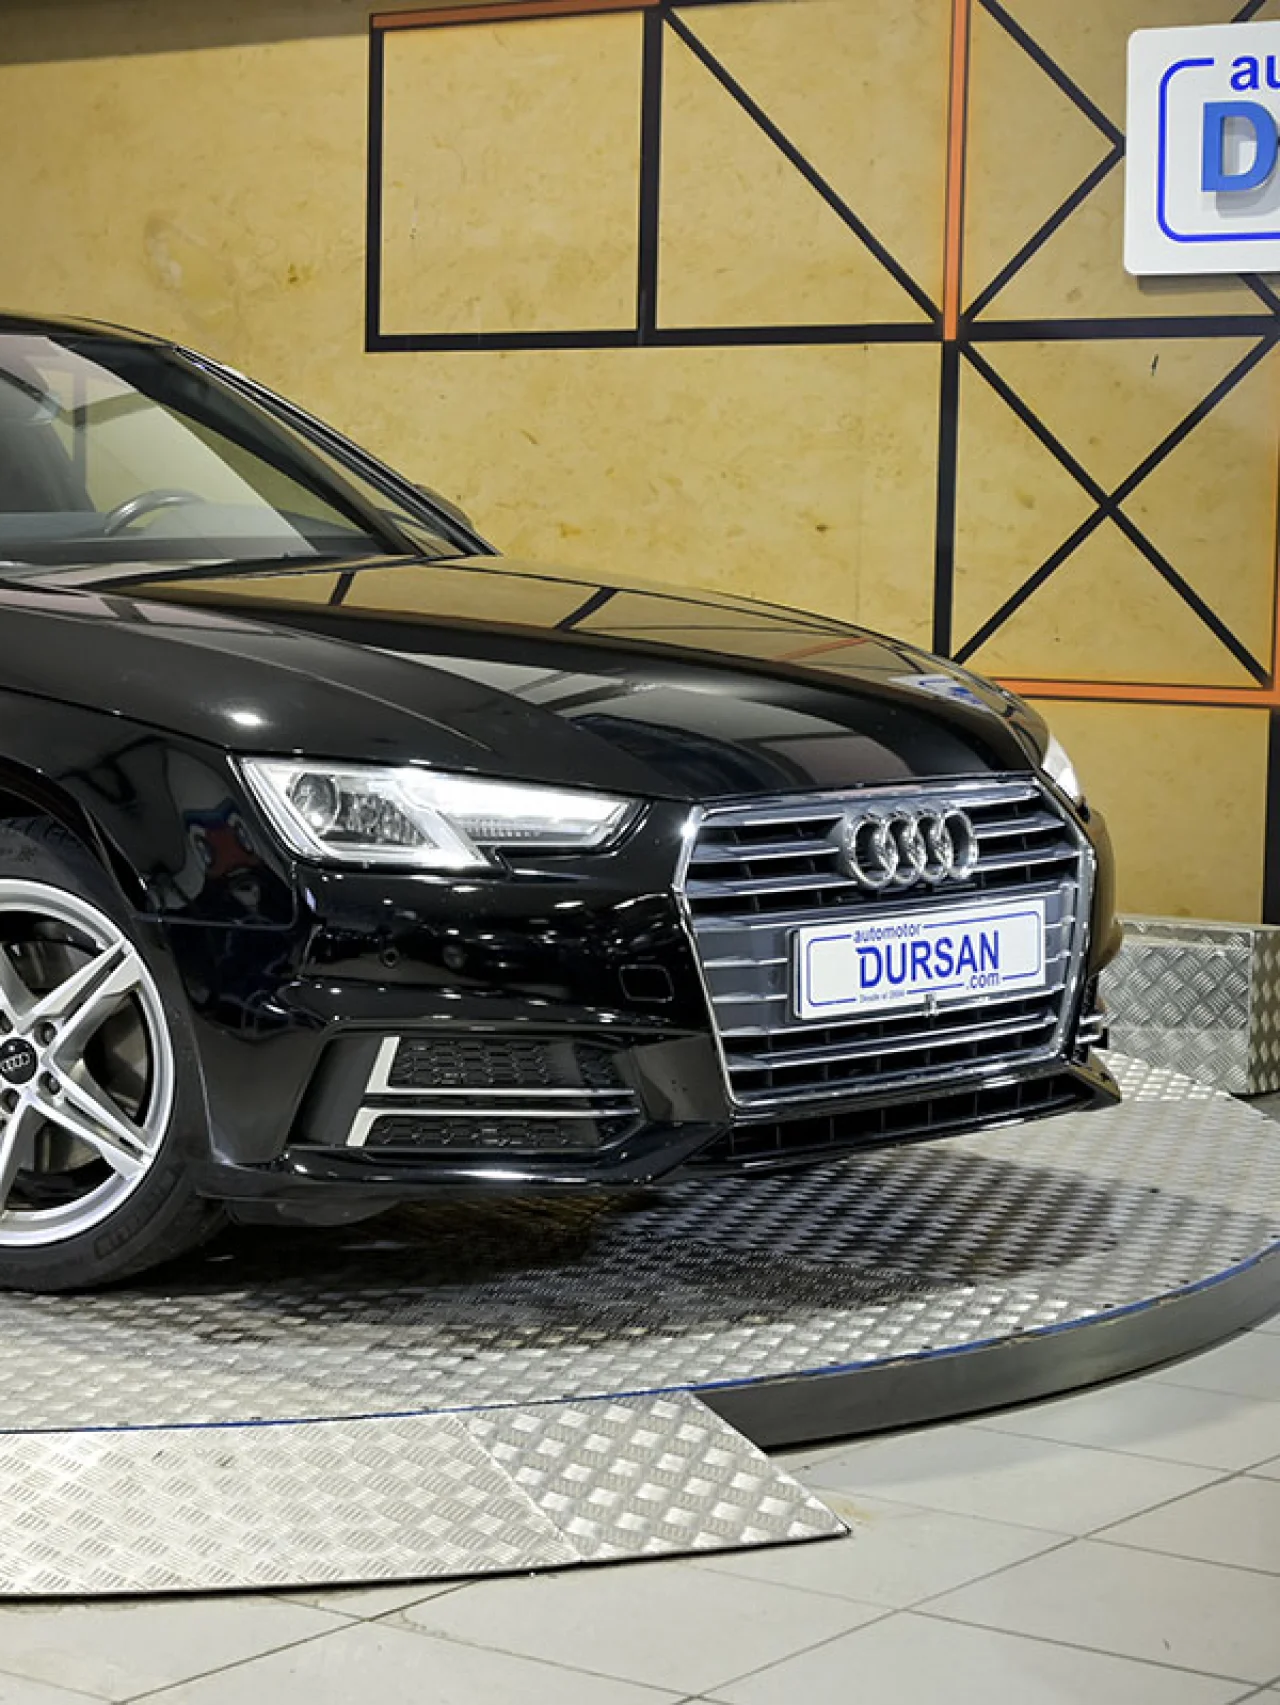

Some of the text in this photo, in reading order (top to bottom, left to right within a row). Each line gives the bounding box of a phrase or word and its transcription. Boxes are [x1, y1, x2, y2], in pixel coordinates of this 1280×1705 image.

[853, 924, 921, 943] automotor
[855, 930, 999, 988] DURSAN
[965, 972, 999, 990] .com
